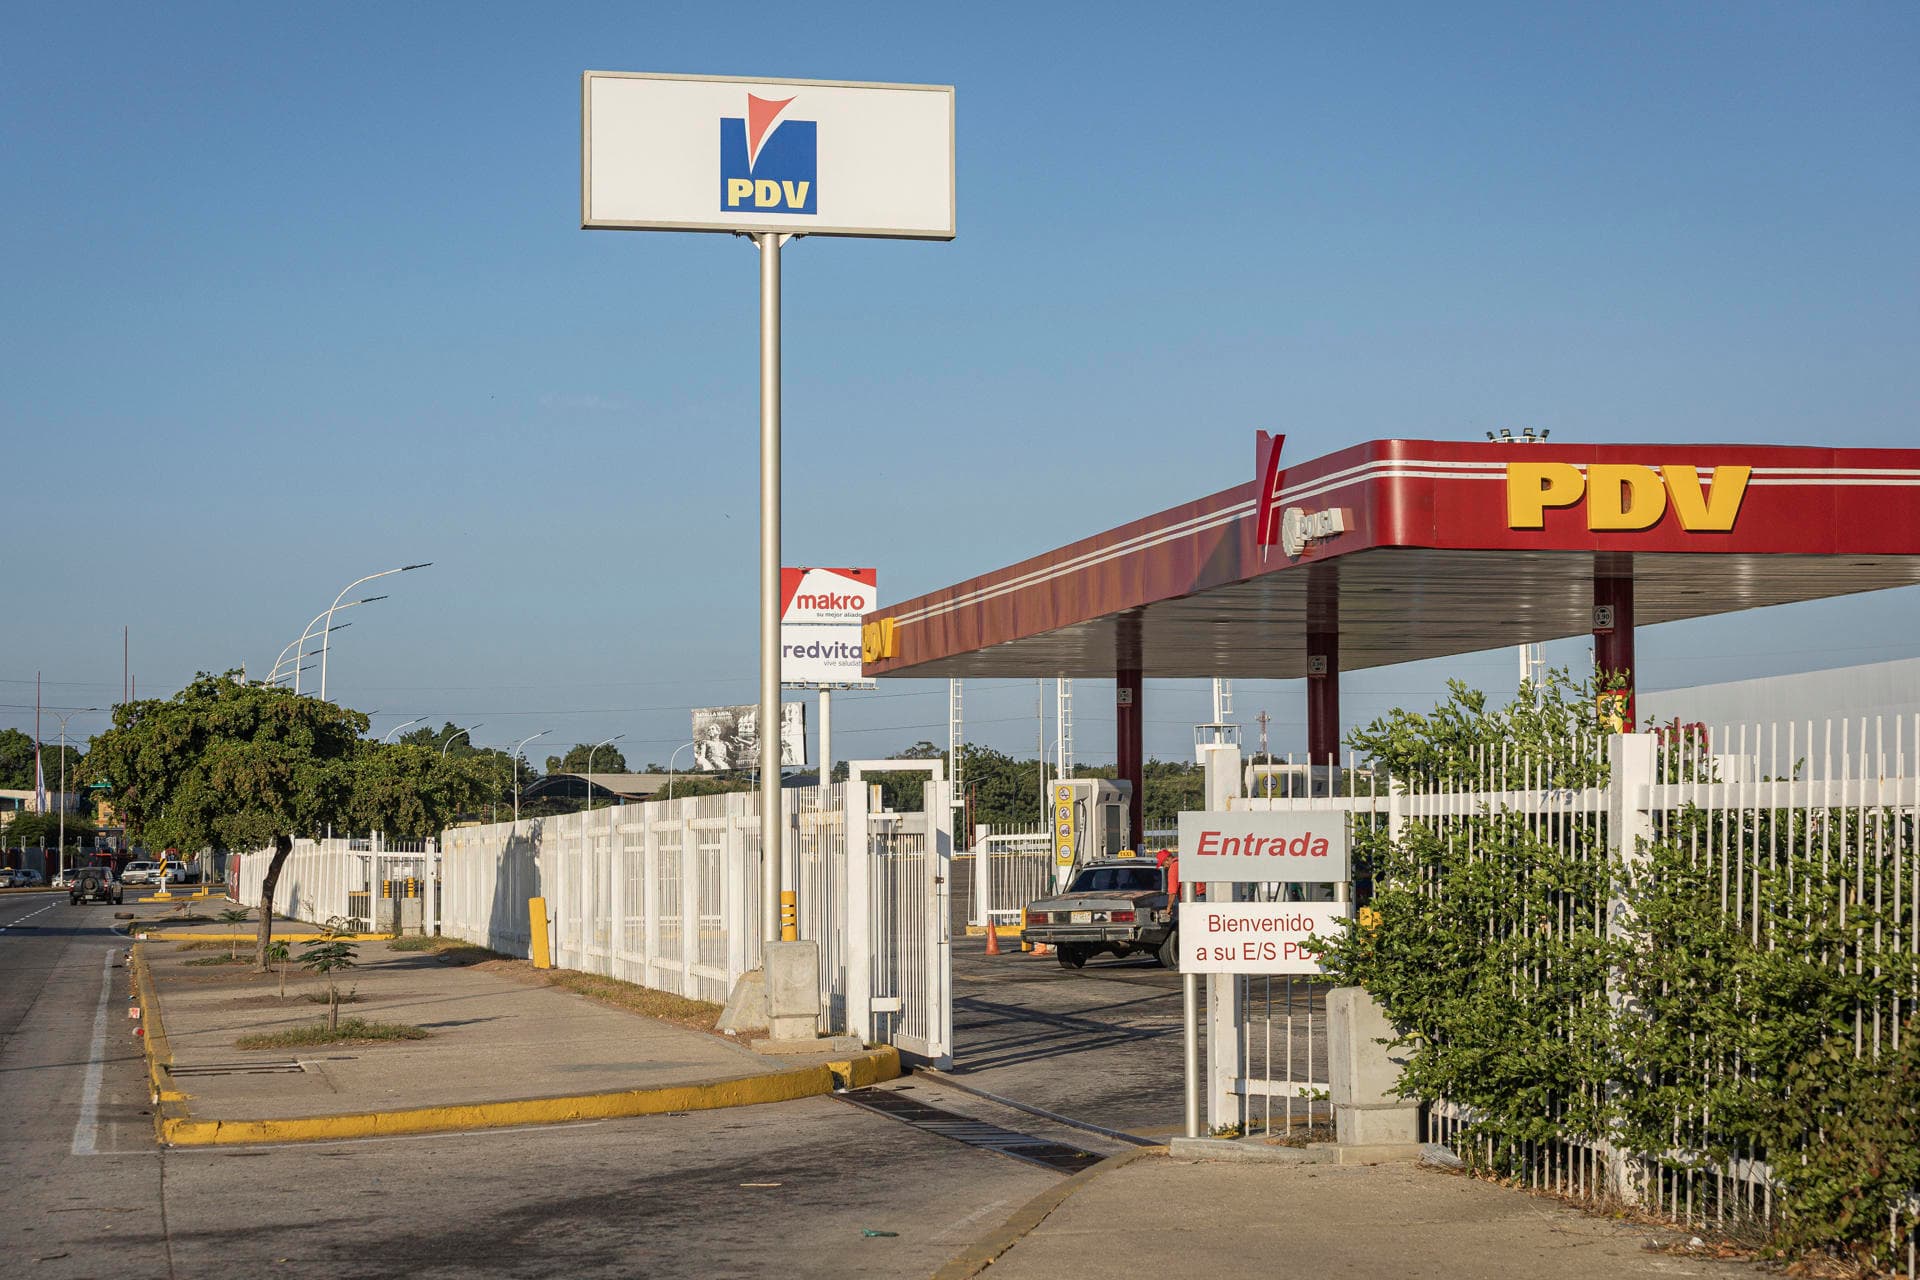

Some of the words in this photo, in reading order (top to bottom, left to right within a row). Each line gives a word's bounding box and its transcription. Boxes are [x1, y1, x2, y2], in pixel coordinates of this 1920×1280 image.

[727, 178, 811, 209] PDV
[1507, 462, 1752, 531] PDV
[797, 592, 865, 610] makro
[783, 641, 862, 659] redvita
[1196, 831, 1330, 857] Entrada
[1208, 913, 1315, 933] Bienvenido
[1196, 947, 1208, 961] a
[1214, 947, 1236, 961] su
[1243, 942, 1277, 961] E/S
